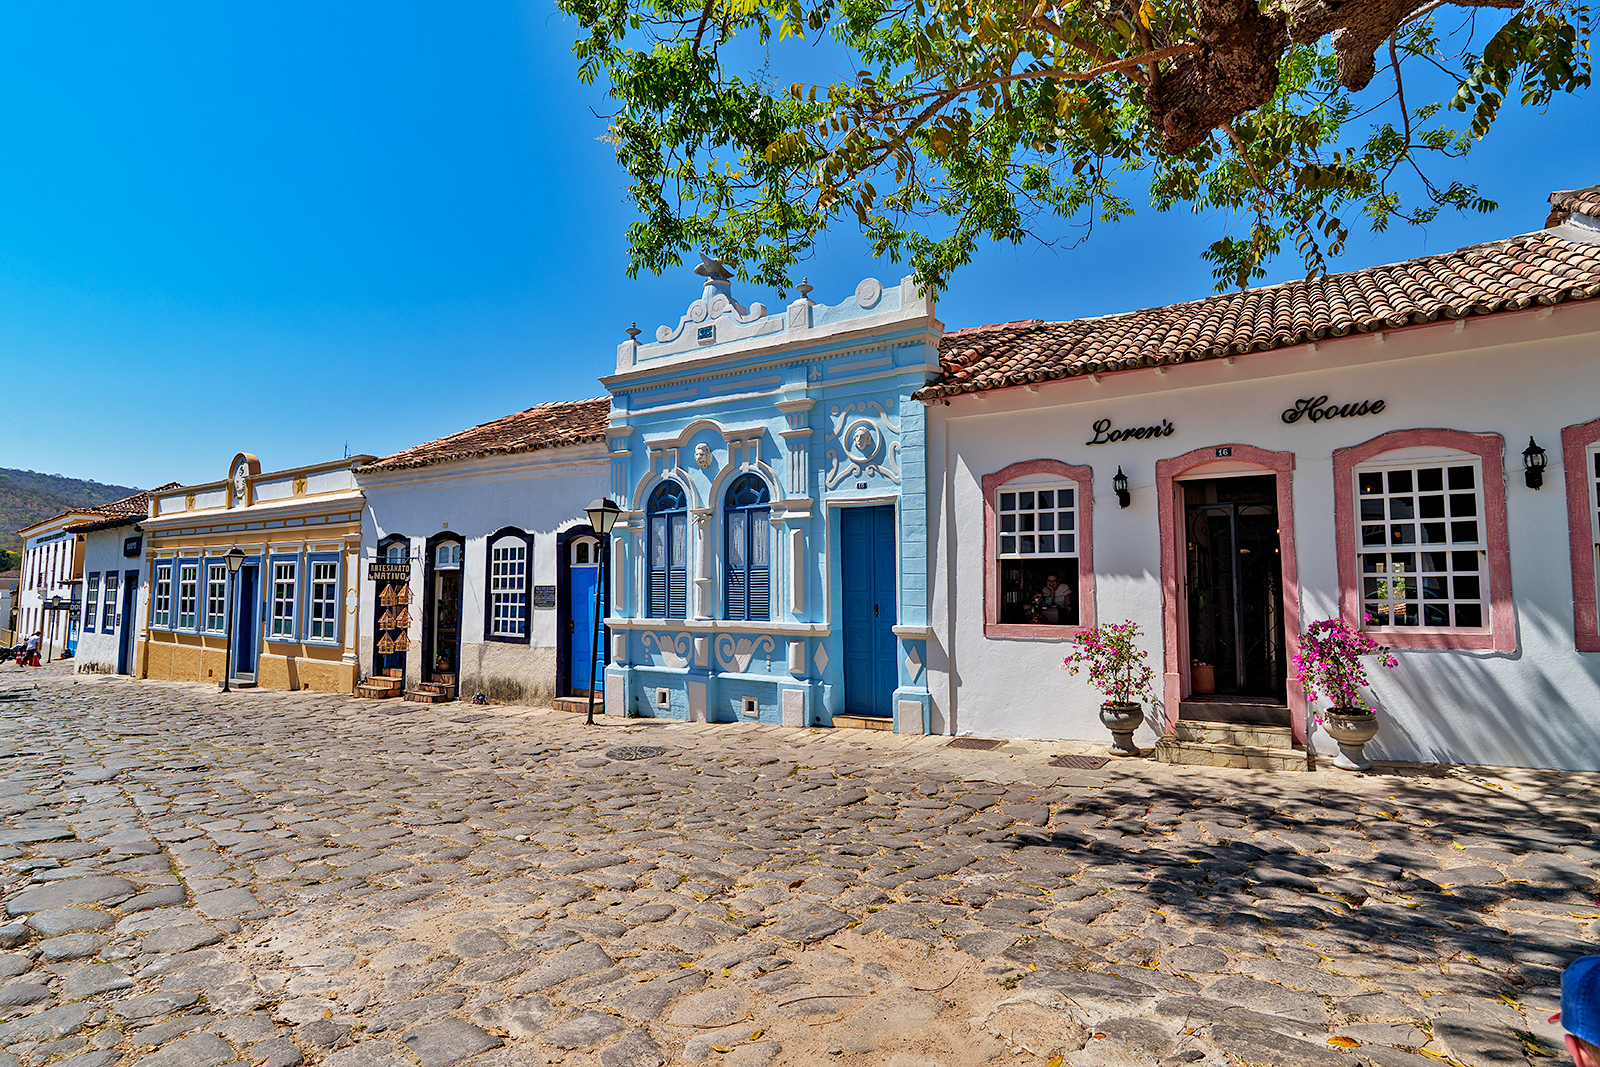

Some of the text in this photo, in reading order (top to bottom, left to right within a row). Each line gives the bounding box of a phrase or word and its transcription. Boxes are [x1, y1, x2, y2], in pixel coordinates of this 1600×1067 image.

[1085, 395, 1386, 446] Loren's House
[1218, 448, 1229, 456] 16
[370, 564, 410, 572] ARTESANATO
[373, 572, 406, 580] NATIVO
